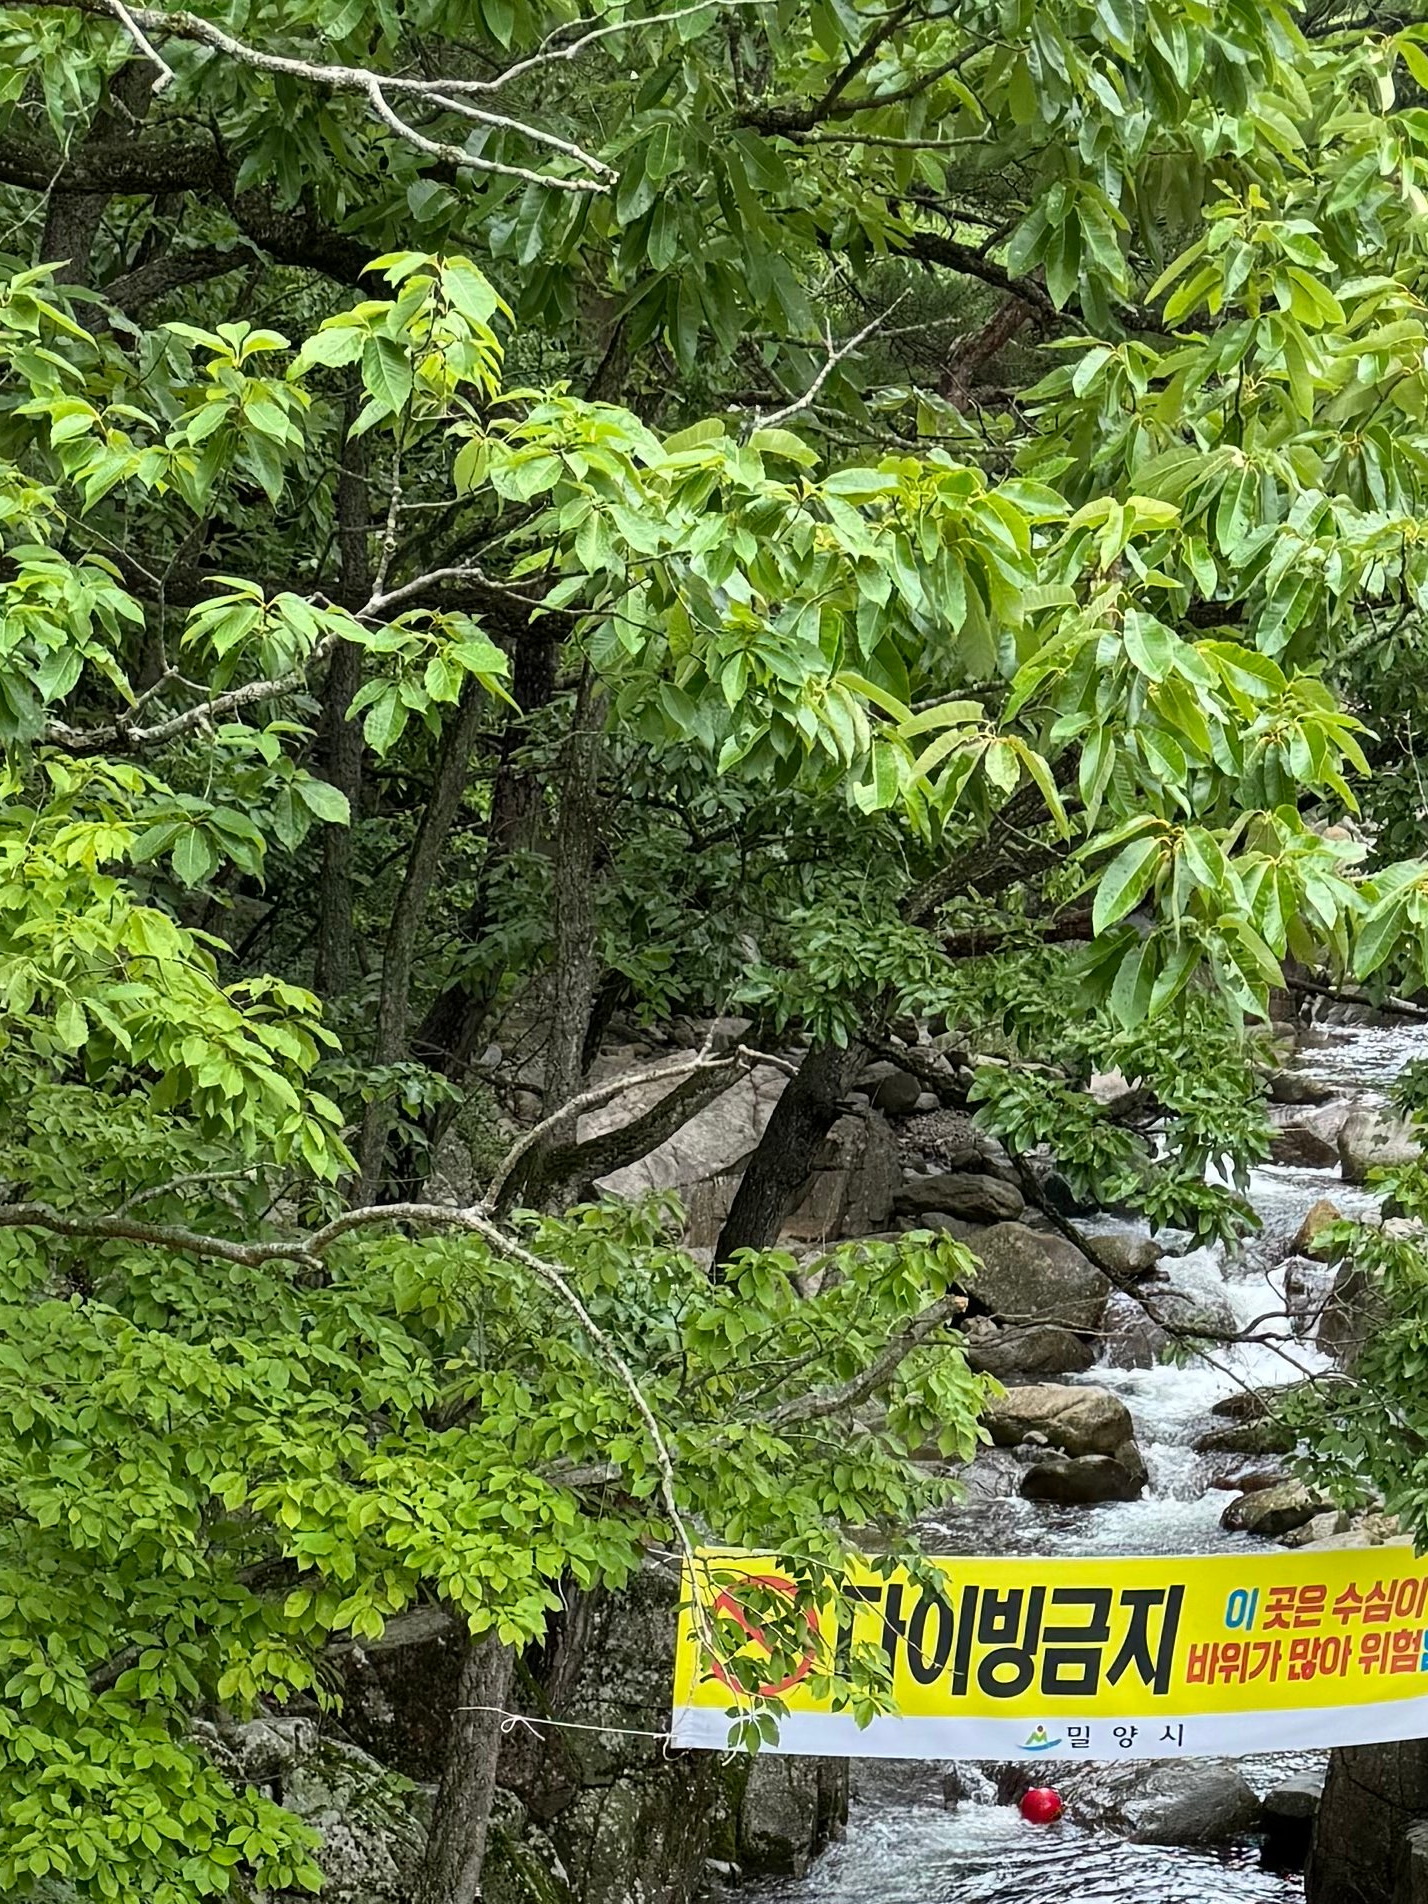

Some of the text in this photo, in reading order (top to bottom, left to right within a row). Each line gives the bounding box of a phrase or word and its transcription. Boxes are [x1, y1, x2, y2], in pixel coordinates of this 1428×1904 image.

[1224, 1587, 1259, 1631] 이
[1262, 1584, 1327, 1630] 곳은
[834, 1583, 1185, 1699] 다이빙금지
[1186, 1641, 1282, 1685] 바위가
[1288, 1635, 1352, 1681] 많아
